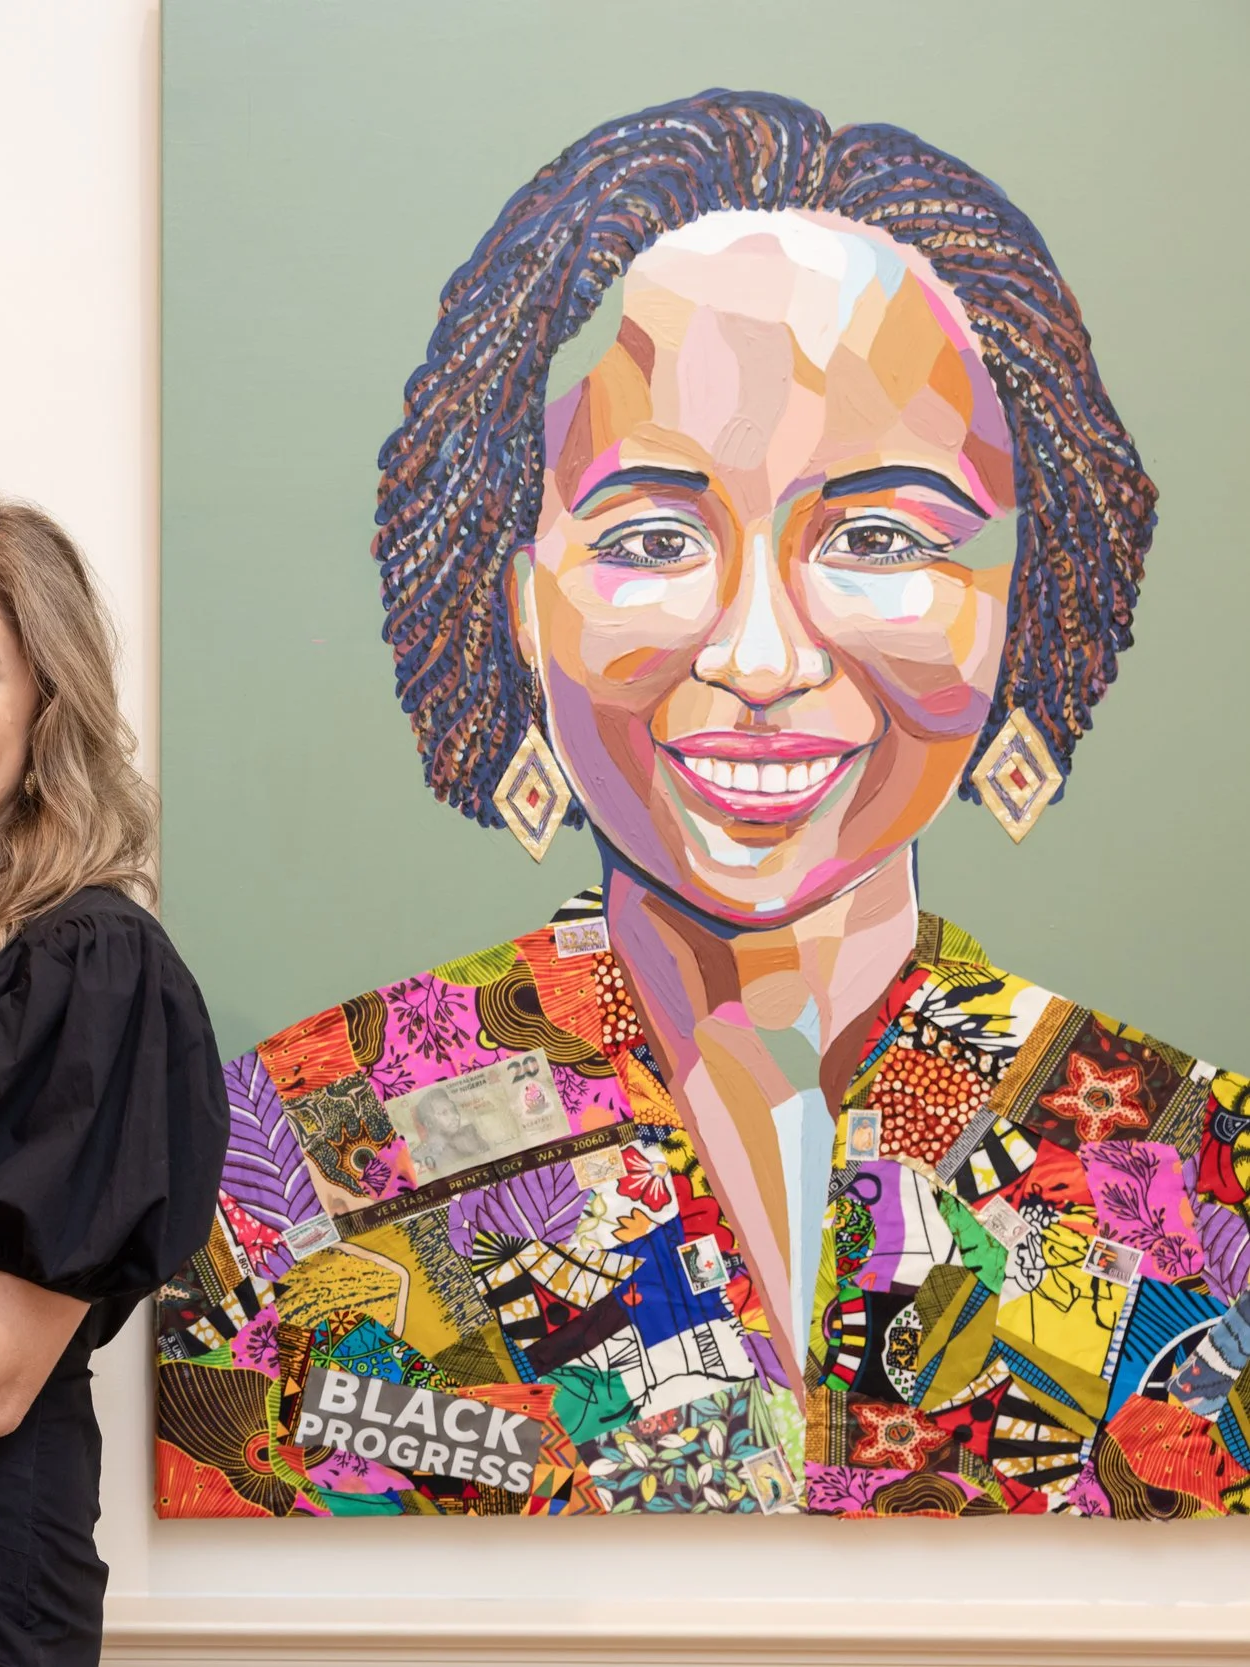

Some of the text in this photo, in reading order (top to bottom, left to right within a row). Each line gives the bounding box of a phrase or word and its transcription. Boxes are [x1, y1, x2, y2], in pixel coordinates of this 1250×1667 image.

[507, 1056, 540, 1084] 20
[460, 1079, 487, 1092] NIGERIA
[417, 1156, 436, 1175] 20
[448, 1170, 490, 1192] PRINTS
[535, 1148, 562, 1164] WAX
[236, 1252, 252, 1276] 1805
[319, 1370, 528, 1455] BLACK
[295, 1412, 534, 1494] PROGRESS
